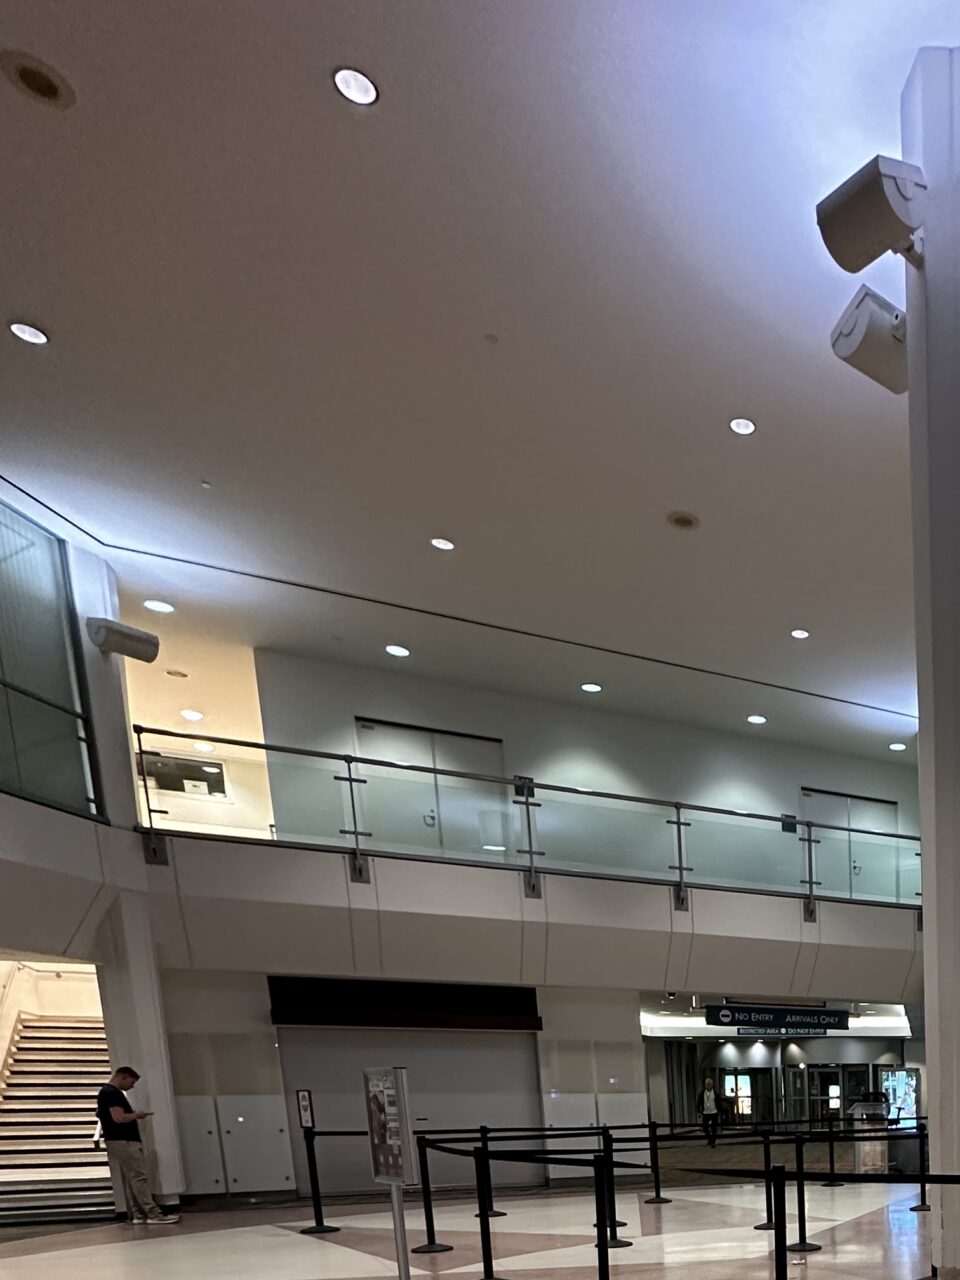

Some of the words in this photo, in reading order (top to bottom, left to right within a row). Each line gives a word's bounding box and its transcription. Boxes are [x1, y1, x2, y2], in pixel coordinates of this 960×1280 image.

[751, 1013, 774, 1021] ENTRY
[785, 1015, 818, 1023] ARRIVALS
[820, 1015, 839, 1024] ONLY
